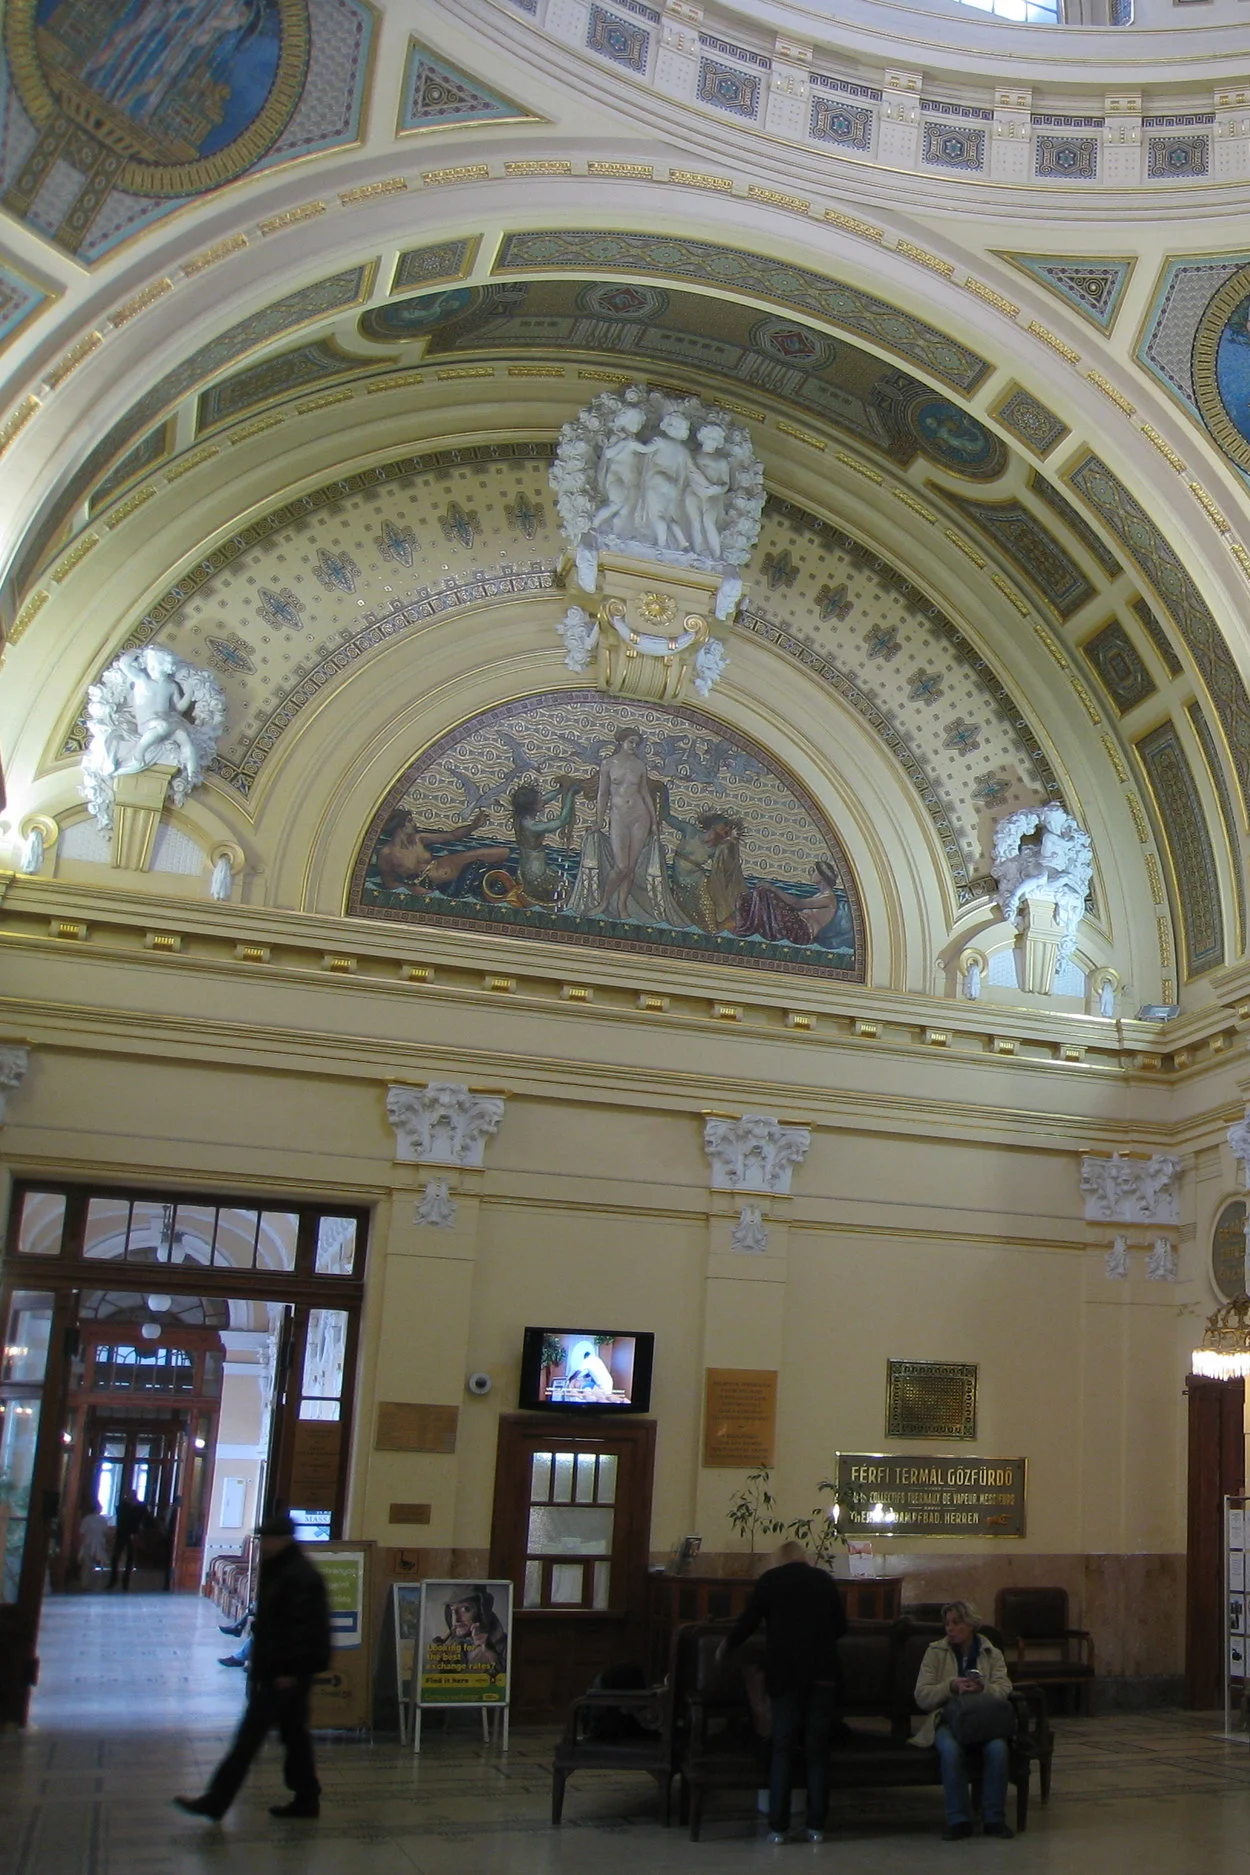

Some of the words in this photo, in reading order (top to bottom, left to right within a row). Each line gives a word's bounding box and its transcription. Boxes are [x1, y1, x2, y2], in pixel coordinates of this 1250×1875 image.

[851, 1463, 890, 1484] FÉRFI
[895, 1465, 945, 1486] TERMÁL
[942, 1493, 951, 1505] DE
[944, 1512, 980, 1525] HERREN
[463, 1642, 477, 1651] for
[426, 1652, 441, 1661] the
[442, 1652, 462, 1661] best
[426, 1661, 467, 1671] exchange
